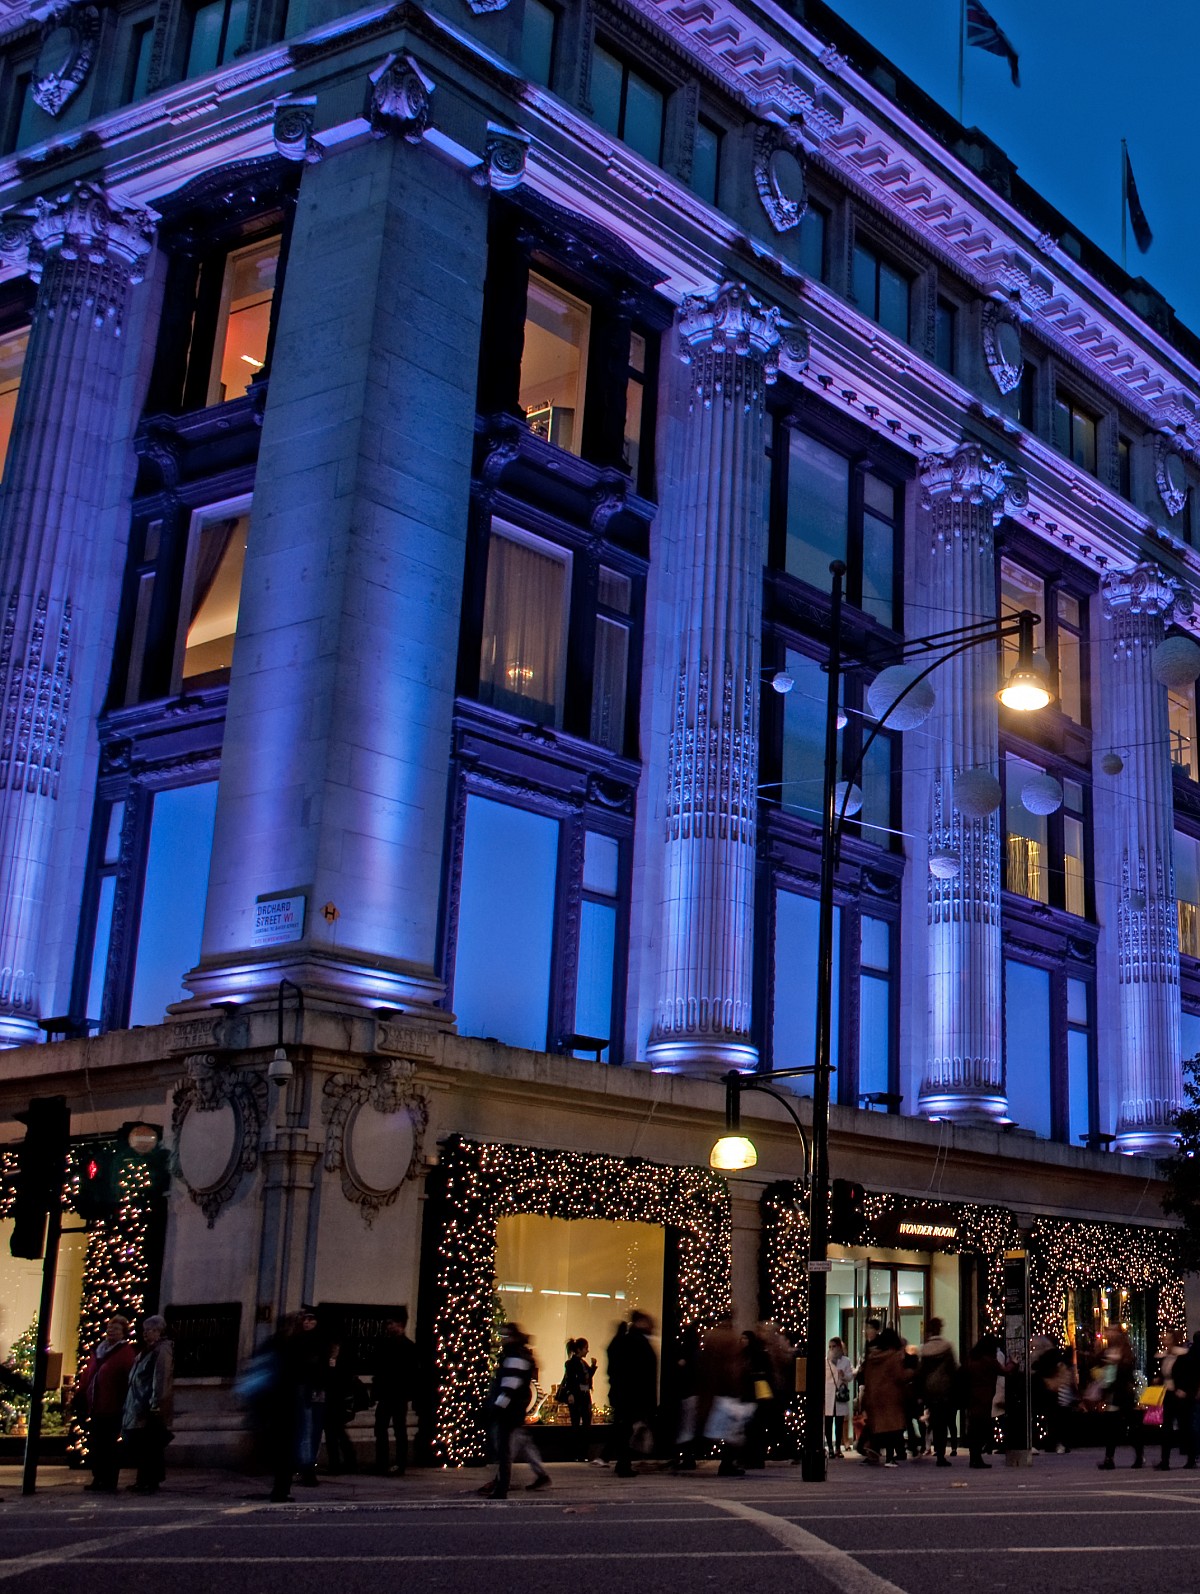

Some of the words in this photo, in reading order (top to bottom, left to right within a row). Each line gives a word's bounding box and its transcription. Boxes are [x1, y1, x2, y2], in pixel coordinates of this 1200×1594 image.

[257, 901, 291, 916] ORCHARD
[256, 914, 282, 927] STREET
[900, 1223, 933, 1236] WONDER
[932, 1226, 957, 1238] ROOM
